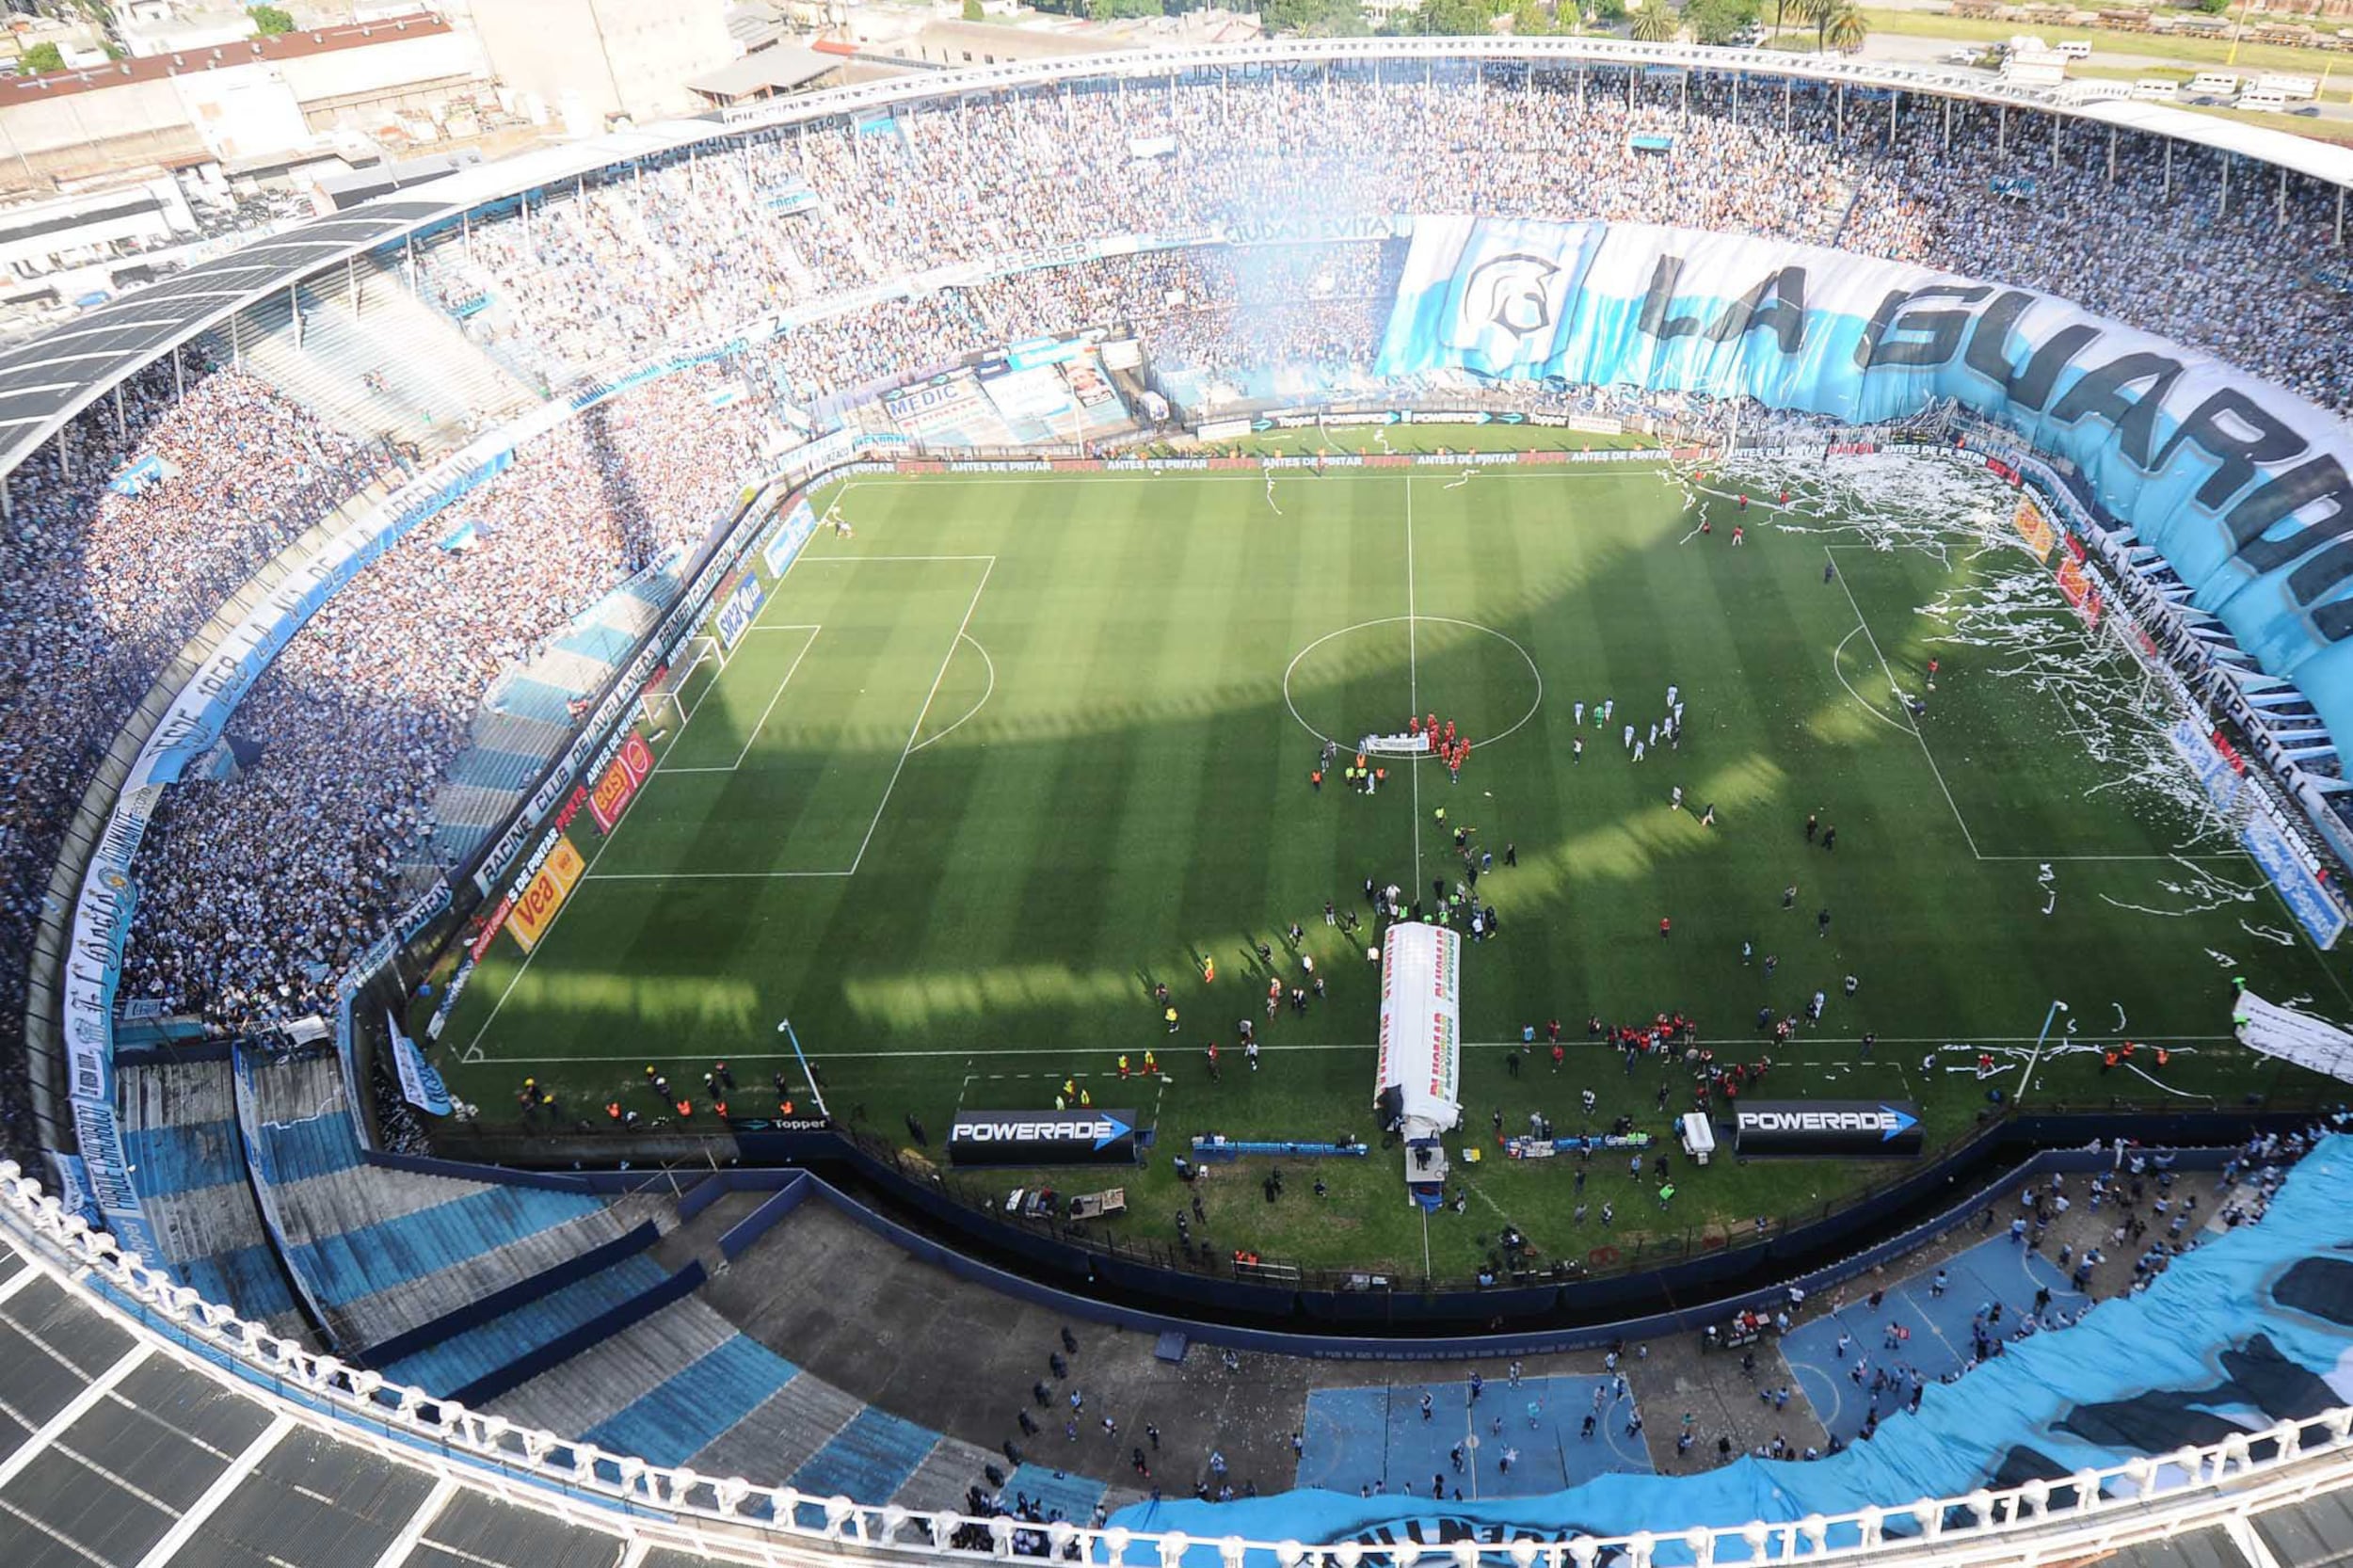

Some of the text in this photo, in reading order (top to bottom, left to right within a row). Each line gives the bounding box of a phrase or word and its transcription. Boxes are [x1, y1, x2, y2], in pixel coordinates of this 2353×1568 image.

[1321, 216, 1391, 237] EVITA
[1636, 253, 1805, 355] LA
[1262, 456, 1302, 469] ANTES
[1417, 453, 1517, 467] ANTES DE PINTAR
[1571, 451, 1607, 463] ANTES
[1609, 450, 1625, 462] DE
[1626, 449, 1672, 461] PINTAR
[1767, 445, 1783, 457] DE
[1882, 444, 1919, 456] ANTES
[1921, 445, 1938, 456] DE
[951, 461, 986, 472] ANTES
[988, 461, 1002, 472] DE
[1003, 460, 1051, 472] PINTAR
[1107, 459, 1143, 472] ANTES
[1144, 459, 1159, 471] DE
[1160, 458, 1207, 471] PINTAR
[197, 658, 243, 709] 1958
[252, 617, 281, 660] LA
[309, 557, 345, 593] DE
[354, 525, 383, 562] LA
[381, 454, 482, 534] ARGENTINA
[535, 767, 570, 813] CLUB
[571, 739, 590, 766] DE
[591, 647, 659, 738] AVELLANEDA
[658, 599, 692, 649] PRIMER
[585, 699, 645, 786] ANTES DE PINTAR
[594, 760, 629, 810] easy
[554, 784, 589, 834] PENTA
[101, 806, 146, 861] DIAMANTE
[514, 868, 532, 893] DE
[526, 827, 559, 877] PINTAR
[517, 874, 554, 928] Vea
[772, 1117, 826, 1131] Topper
[951, 1118, 1113, 1143] POWERADE
[1737, 1111, 1899, 1131] POWERADE
[91, 1166, 136, 1212] PARQUE
